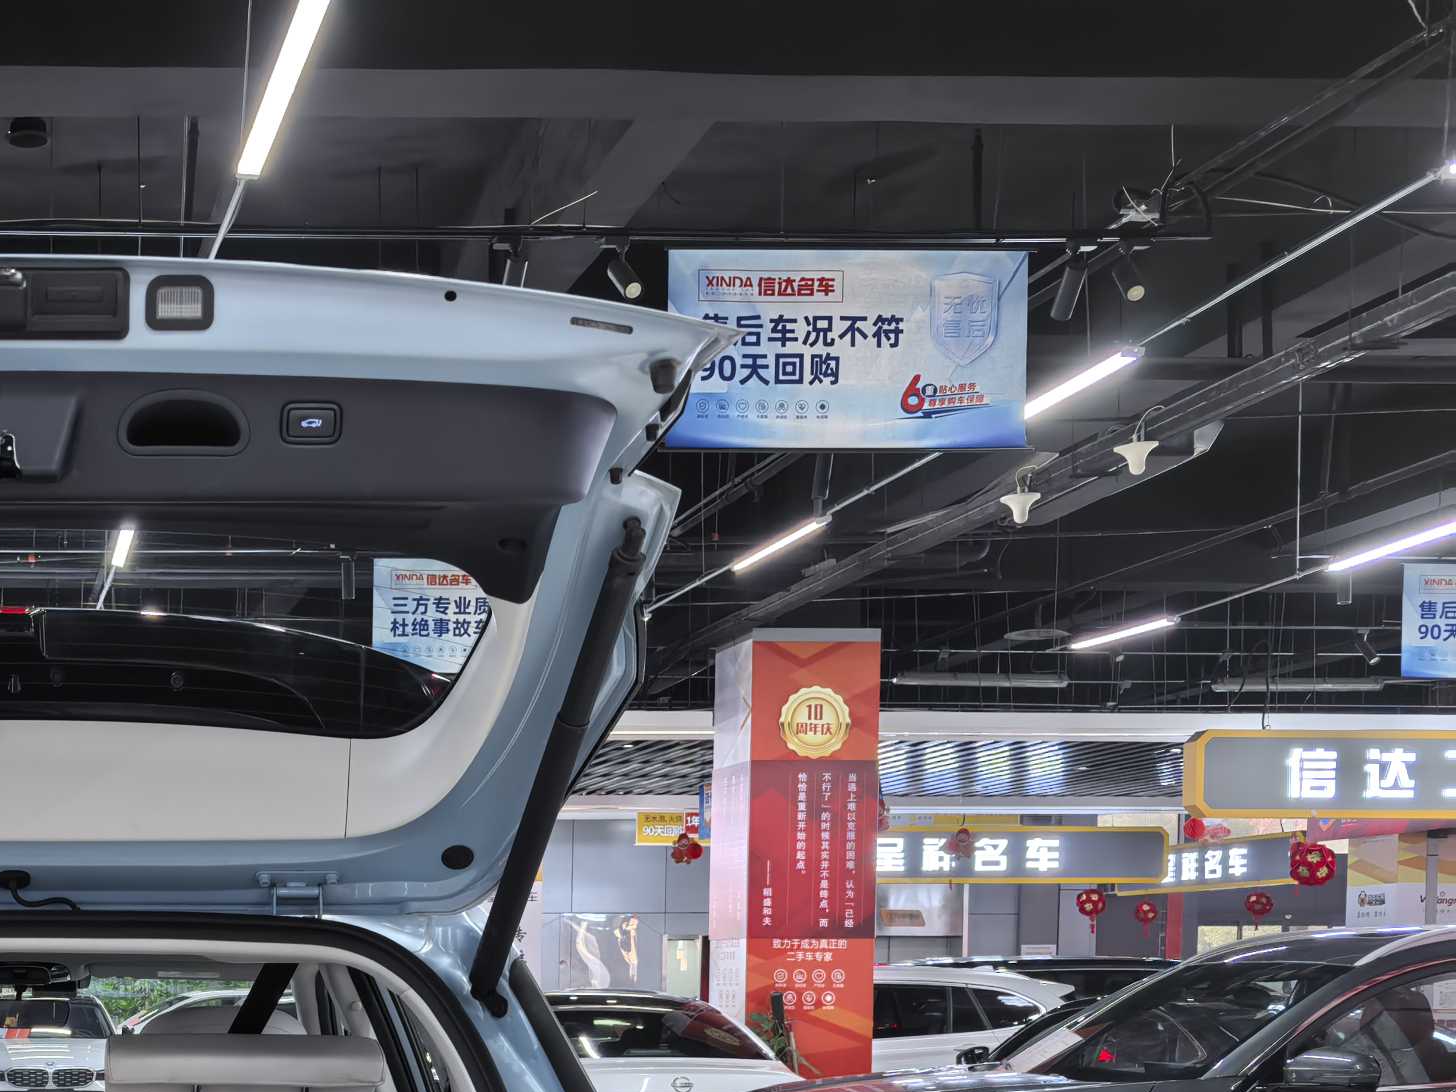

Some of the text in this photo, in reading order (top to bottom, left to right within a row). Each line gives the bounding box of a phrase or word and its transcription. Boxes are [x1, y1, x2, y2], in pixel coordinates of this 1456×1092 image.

[705, 276, 753, 288] XINDA
[758, 276, 835, 296] 信达名车
[701, 353, 840, 386] 90天回购
[426, 574, 472, 586] 信达名车
[391, 596, 489, 615] 三方专业质
[1419, 601, 1456, 620] 售后
[806, 704, 823, 720] 10
[796, 722, 834, 736] 周年庆
[773, 938, 848, 950] 致力于成为真正的
[786, 952, 834, 962] 二手车专家
